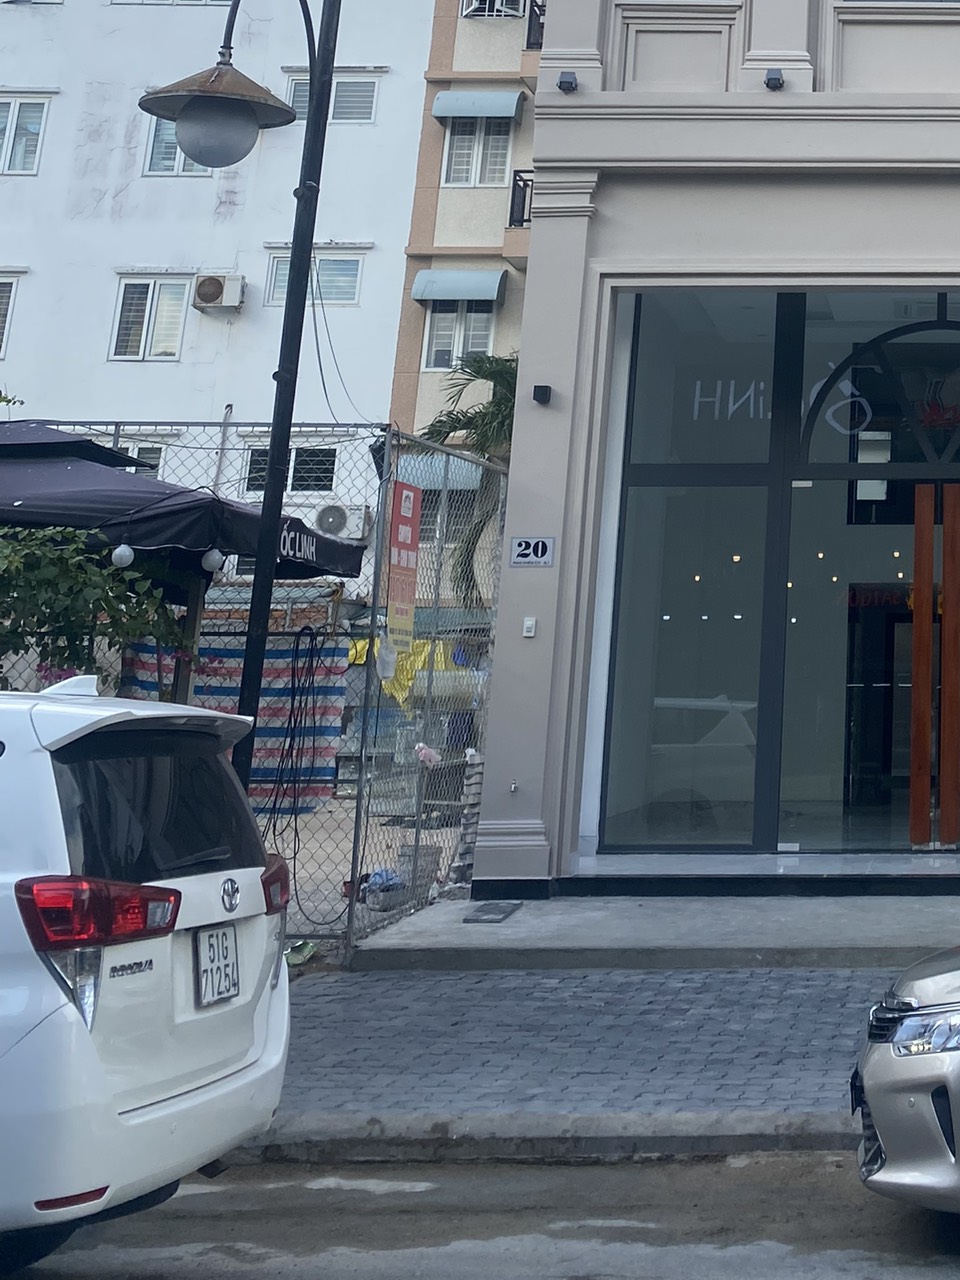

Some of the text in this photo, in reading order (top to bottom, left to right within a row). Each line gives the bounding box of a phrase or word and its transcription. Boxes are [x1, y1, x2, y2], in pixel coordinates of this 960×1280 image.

[295, 532, 317, 562] LINH
[516, 540, 548, 559] 20
[207, 931, 229, 964] 51G
